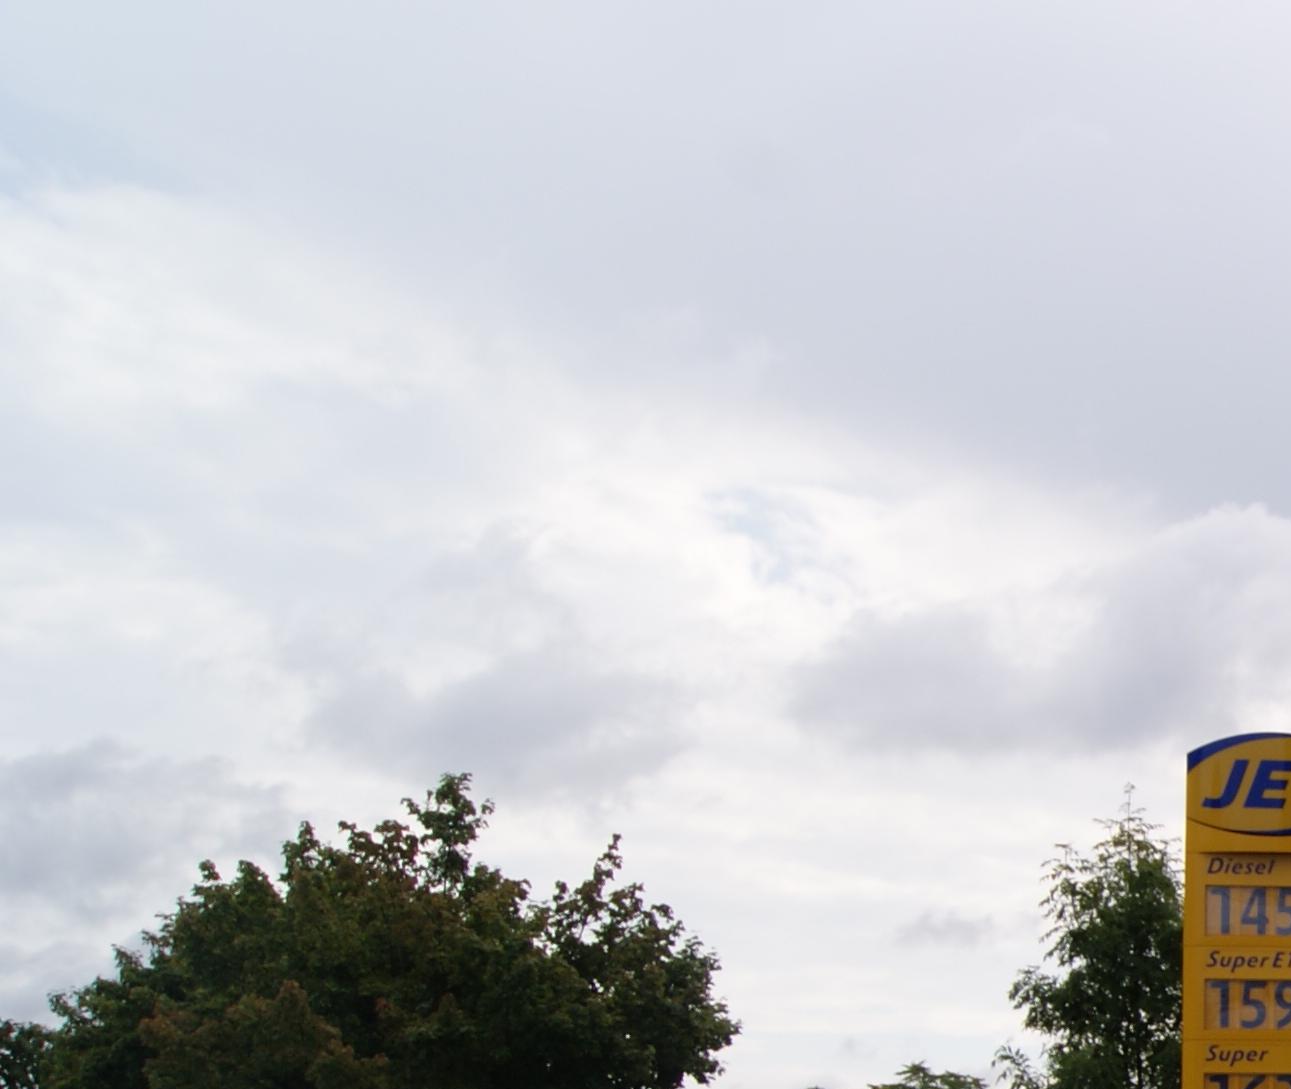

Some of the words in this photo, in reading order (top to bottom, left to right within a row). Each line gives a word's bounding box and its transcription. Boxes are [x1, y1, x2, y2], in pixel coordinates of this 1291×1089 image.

[1206, 857, 1276, 876] Diesel
[1205, 950, 1269, 973] Super
[1205, 1044, 1269, 1067] Super
